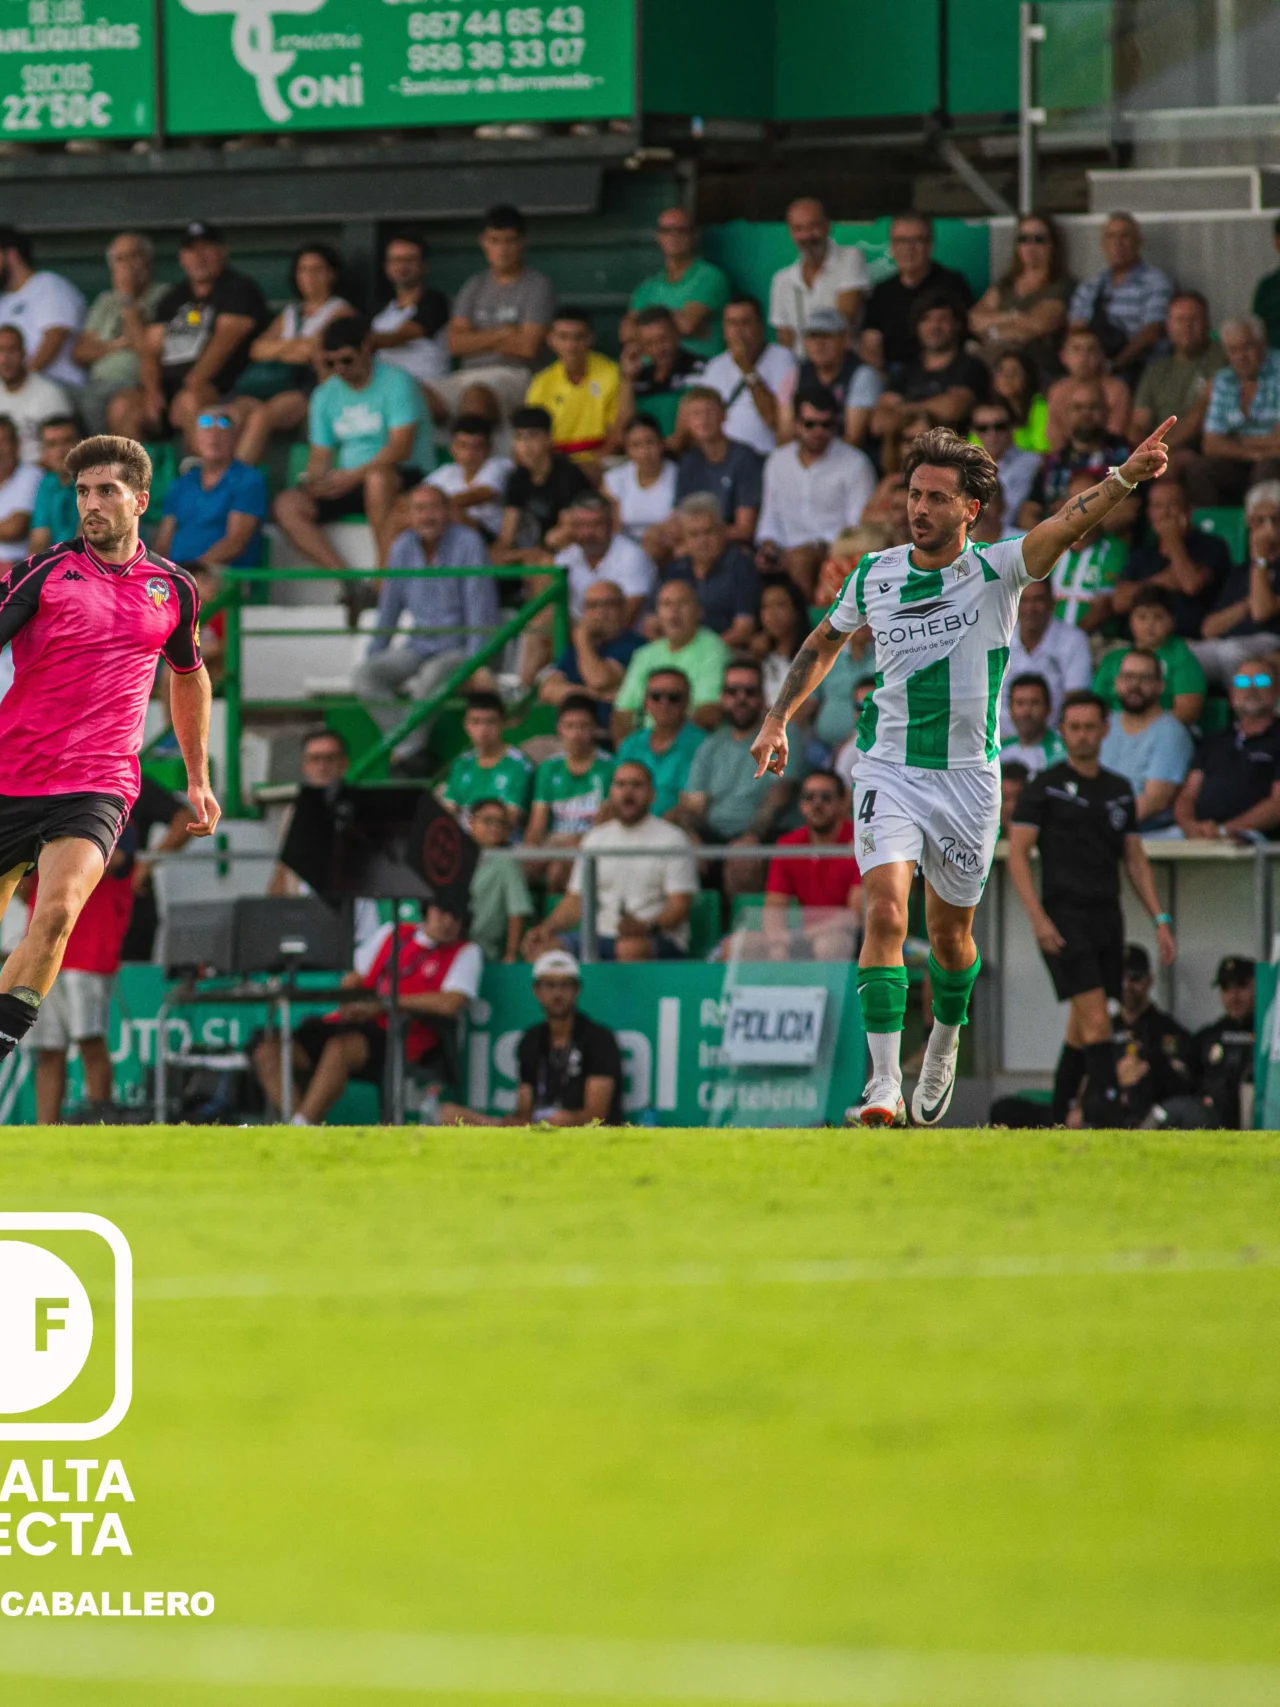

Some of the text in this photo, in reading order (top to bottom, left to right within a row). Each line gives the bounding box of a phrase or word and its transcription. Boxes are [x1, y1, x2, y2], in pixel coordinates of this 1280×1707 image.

[464, 10, 502, 36] 44
[546, 5, 584, 34] 43
[508, 39, 545, 69] 33
[549, 37, 585, 66] 07
[20, 62, 94, 93] SOCIOS
[877, 610, 979, 647] COHEBU
[858, 789, 878, 824] 4
